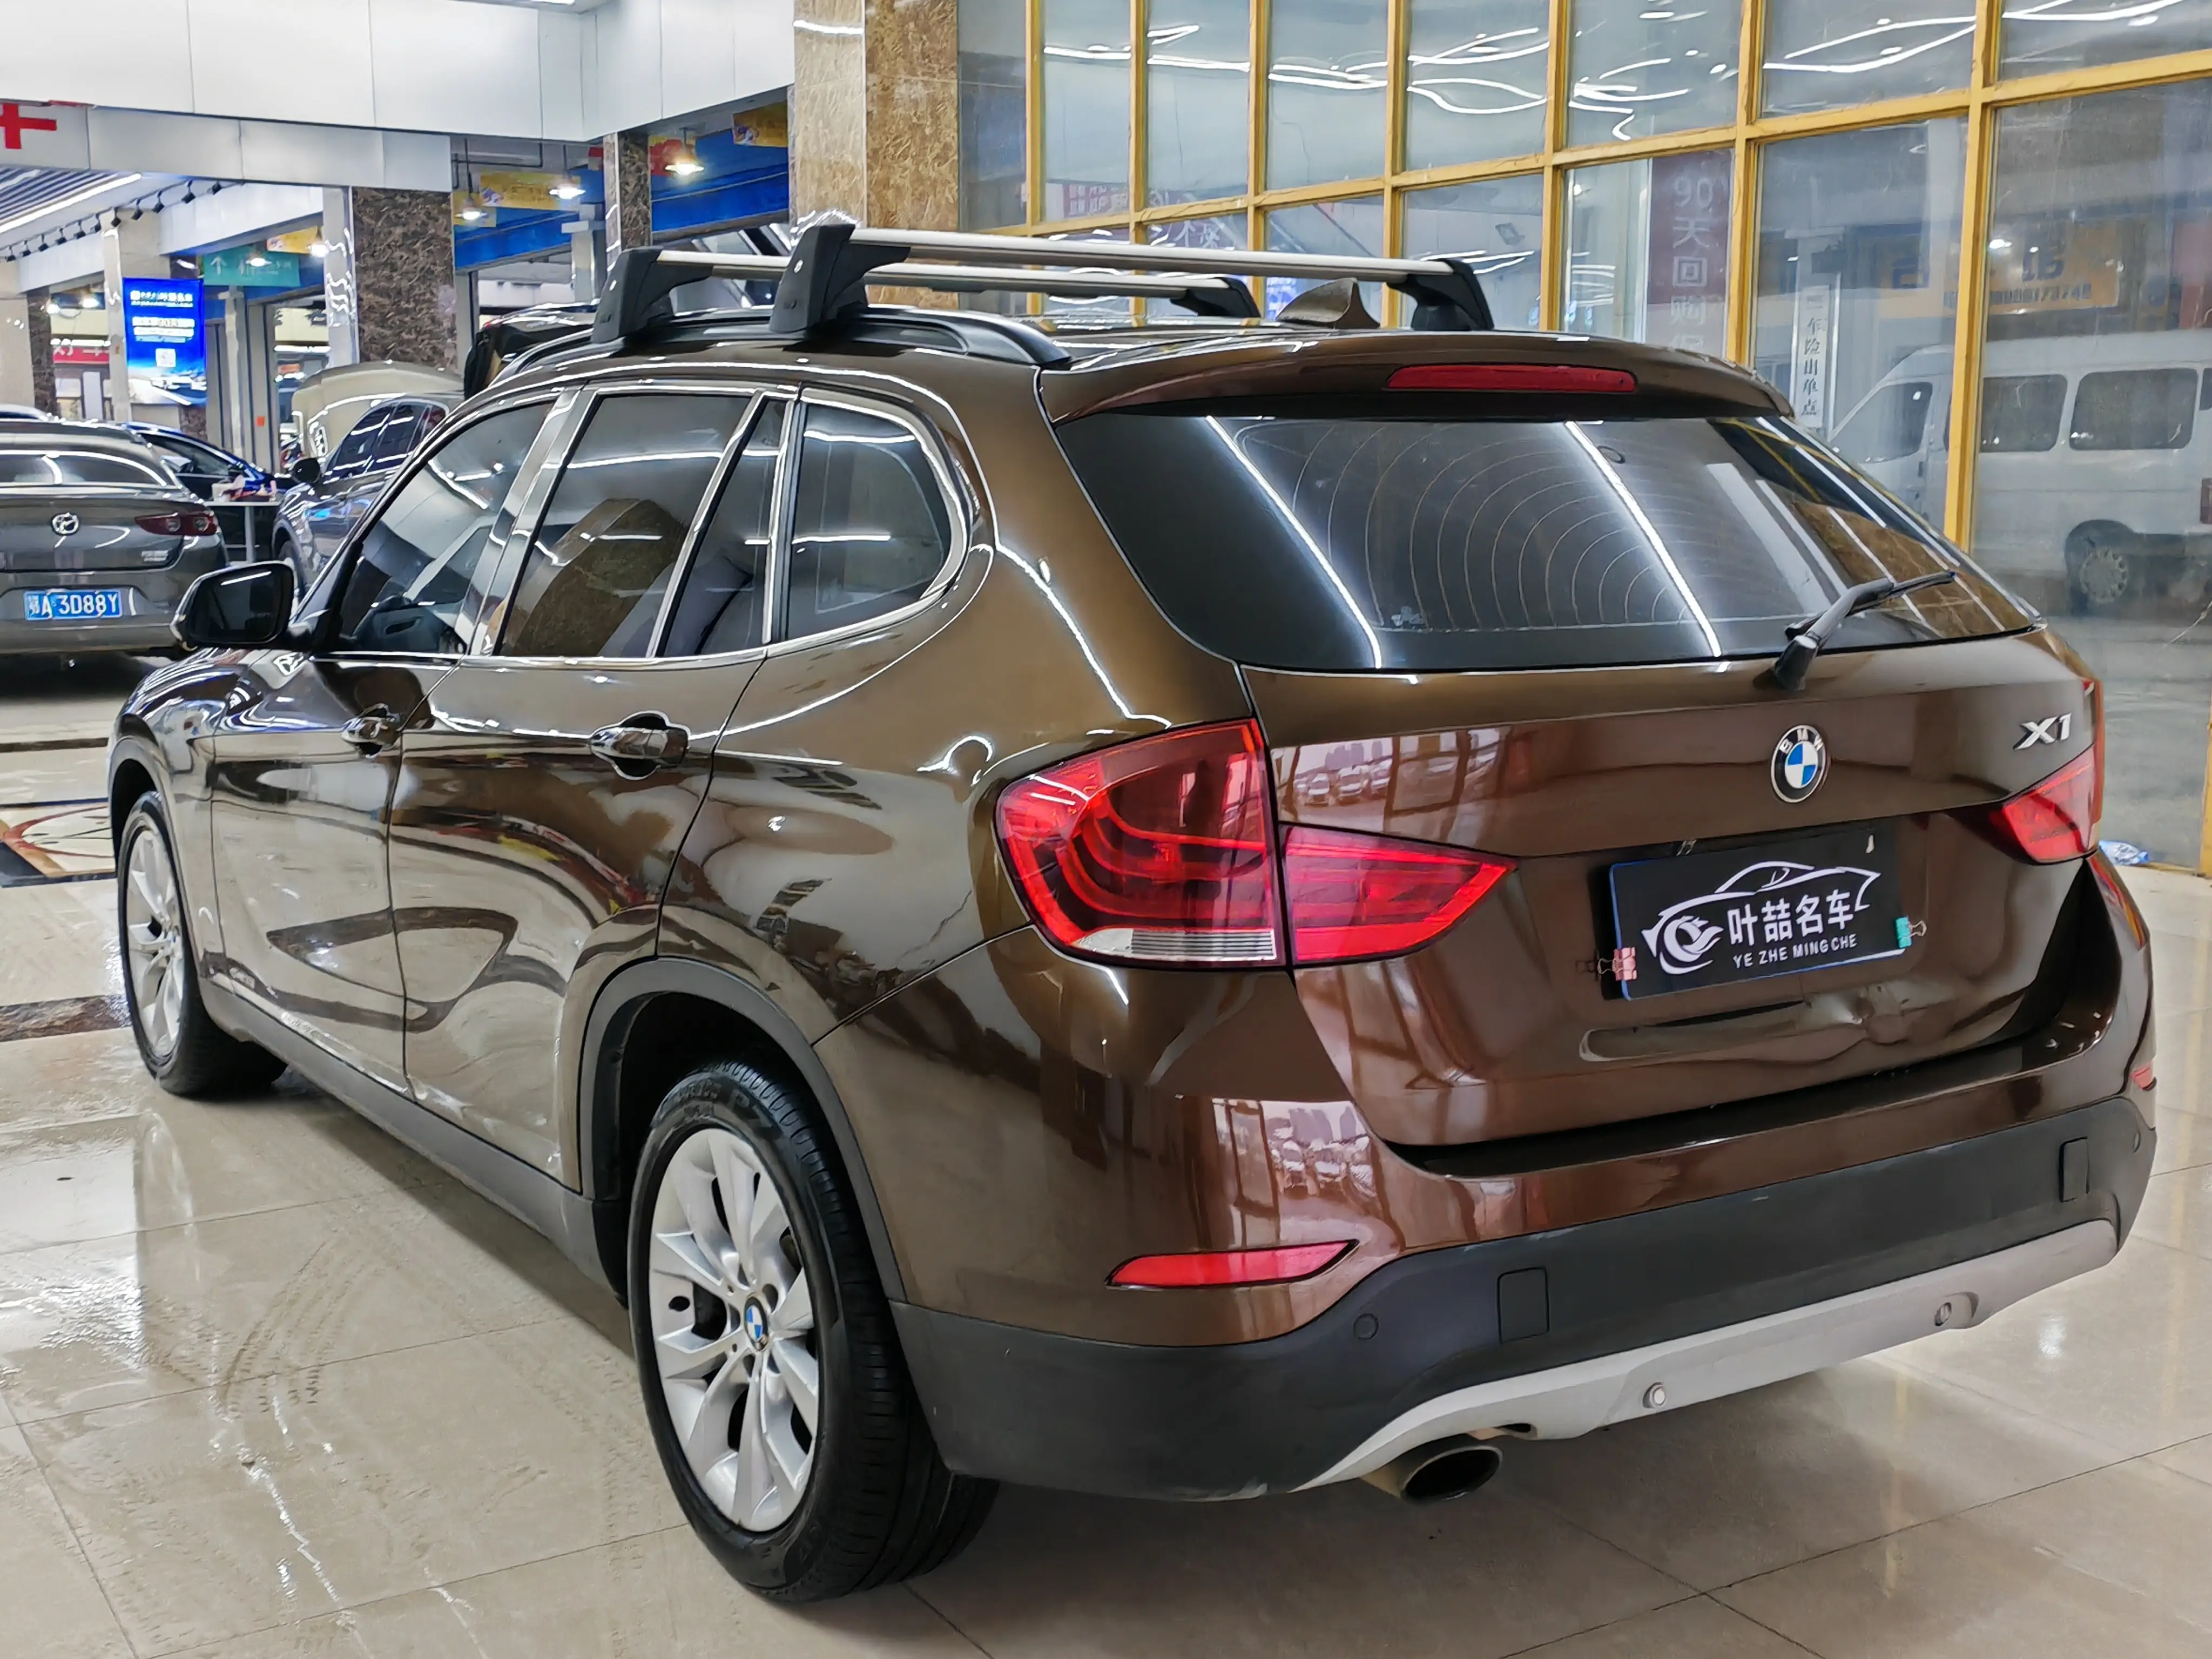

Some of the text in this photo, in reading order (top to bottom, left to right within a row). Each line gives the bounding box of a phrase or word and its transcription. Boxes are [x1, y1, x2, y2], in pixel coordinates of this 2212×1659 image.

[1779, 729, 1824, 754] BMW
[2013, 713, 2072, 750] X1
[1727, 889, 1854, 946] 叶喆名车
[1732, 952, 1754, 969] YE
[1758, 946, 1789, 965] ZHE
